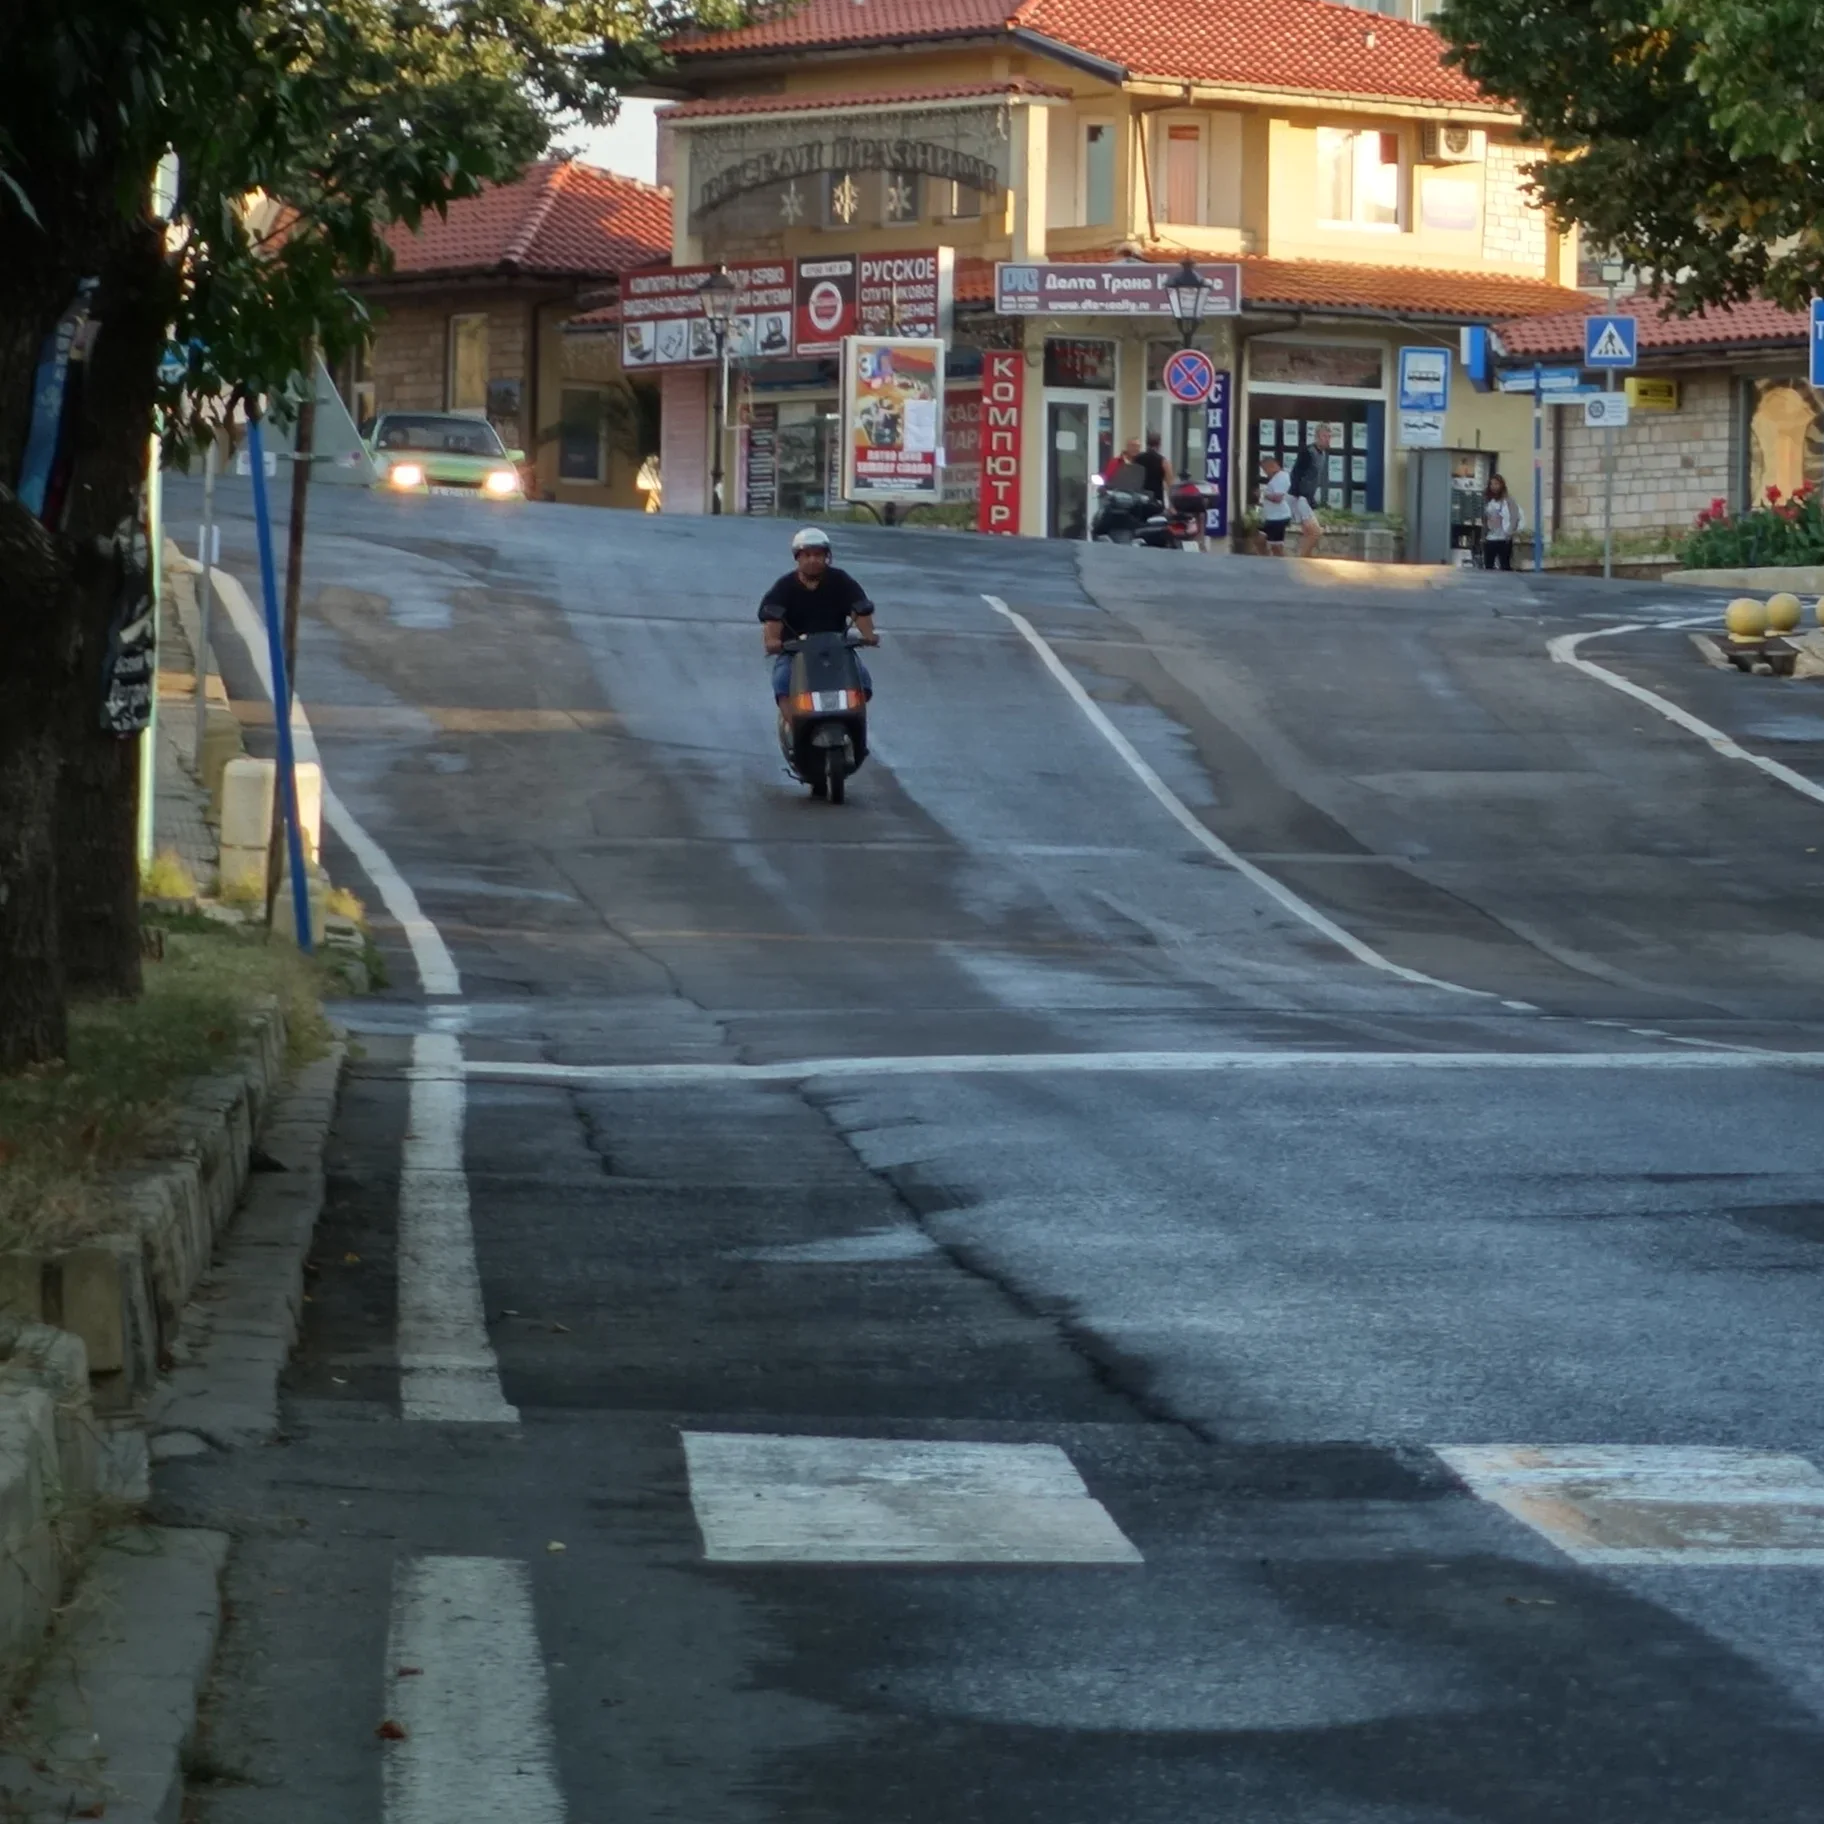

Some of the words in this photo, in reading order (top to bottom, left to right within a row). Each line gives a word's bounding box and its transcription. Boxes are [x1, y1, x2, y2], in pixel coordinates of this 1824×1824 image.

[861, 257, 936, 282] РУССКОЕ
[1045, 273, 1097, 290] Делта
[1101, 273, 1151, 294] Транс
[861, 302, 936, 322] ТЕЛЕДЕНИЕ
[986, 357, 1018, 533] КОМПЮТР
